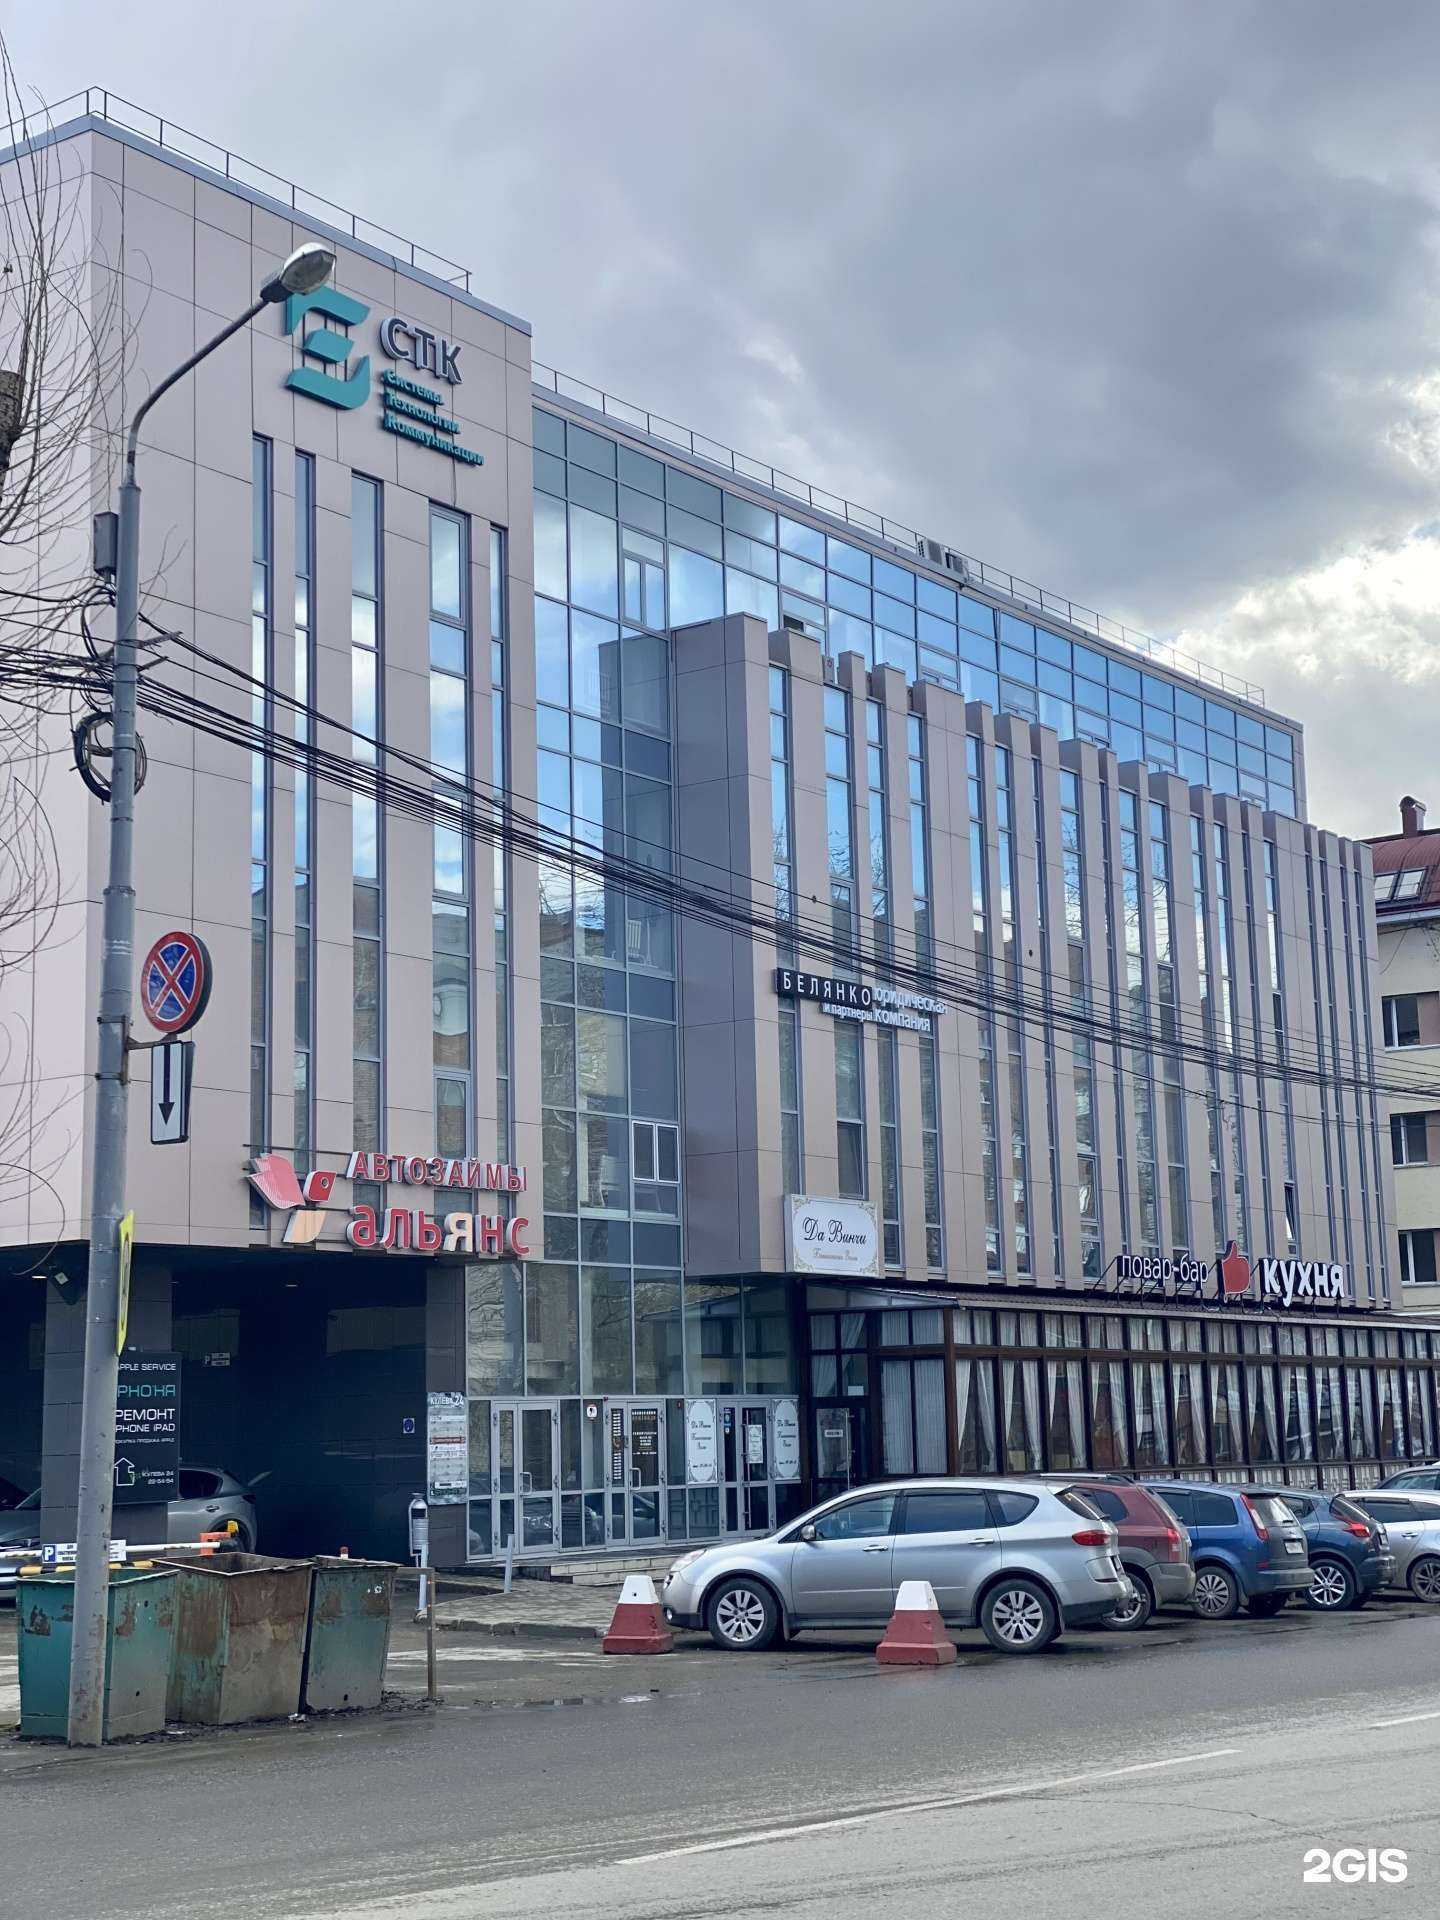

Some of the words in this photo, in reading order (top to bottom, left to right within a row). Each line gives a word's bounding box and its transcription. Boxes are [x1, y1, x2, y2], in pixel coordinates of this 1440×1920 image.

[381, 316, 463, 384] СТК
[783, 971, 871, 1006] БЕЛЯНКО
[348, 1151, 527, 1192] АВТОЗАЙМЫ
[802, 1217, 825, 1242] Да
[1122, 1253, 1209, 1289] повар-бар
[118, 1363, 139, 1371] PPLE
[141, 1363, 177, 1371] SERVICE
[115, 1408, 176, 1421] РЕМОНТ
[115, 1424, 150, 1432] PHONE
